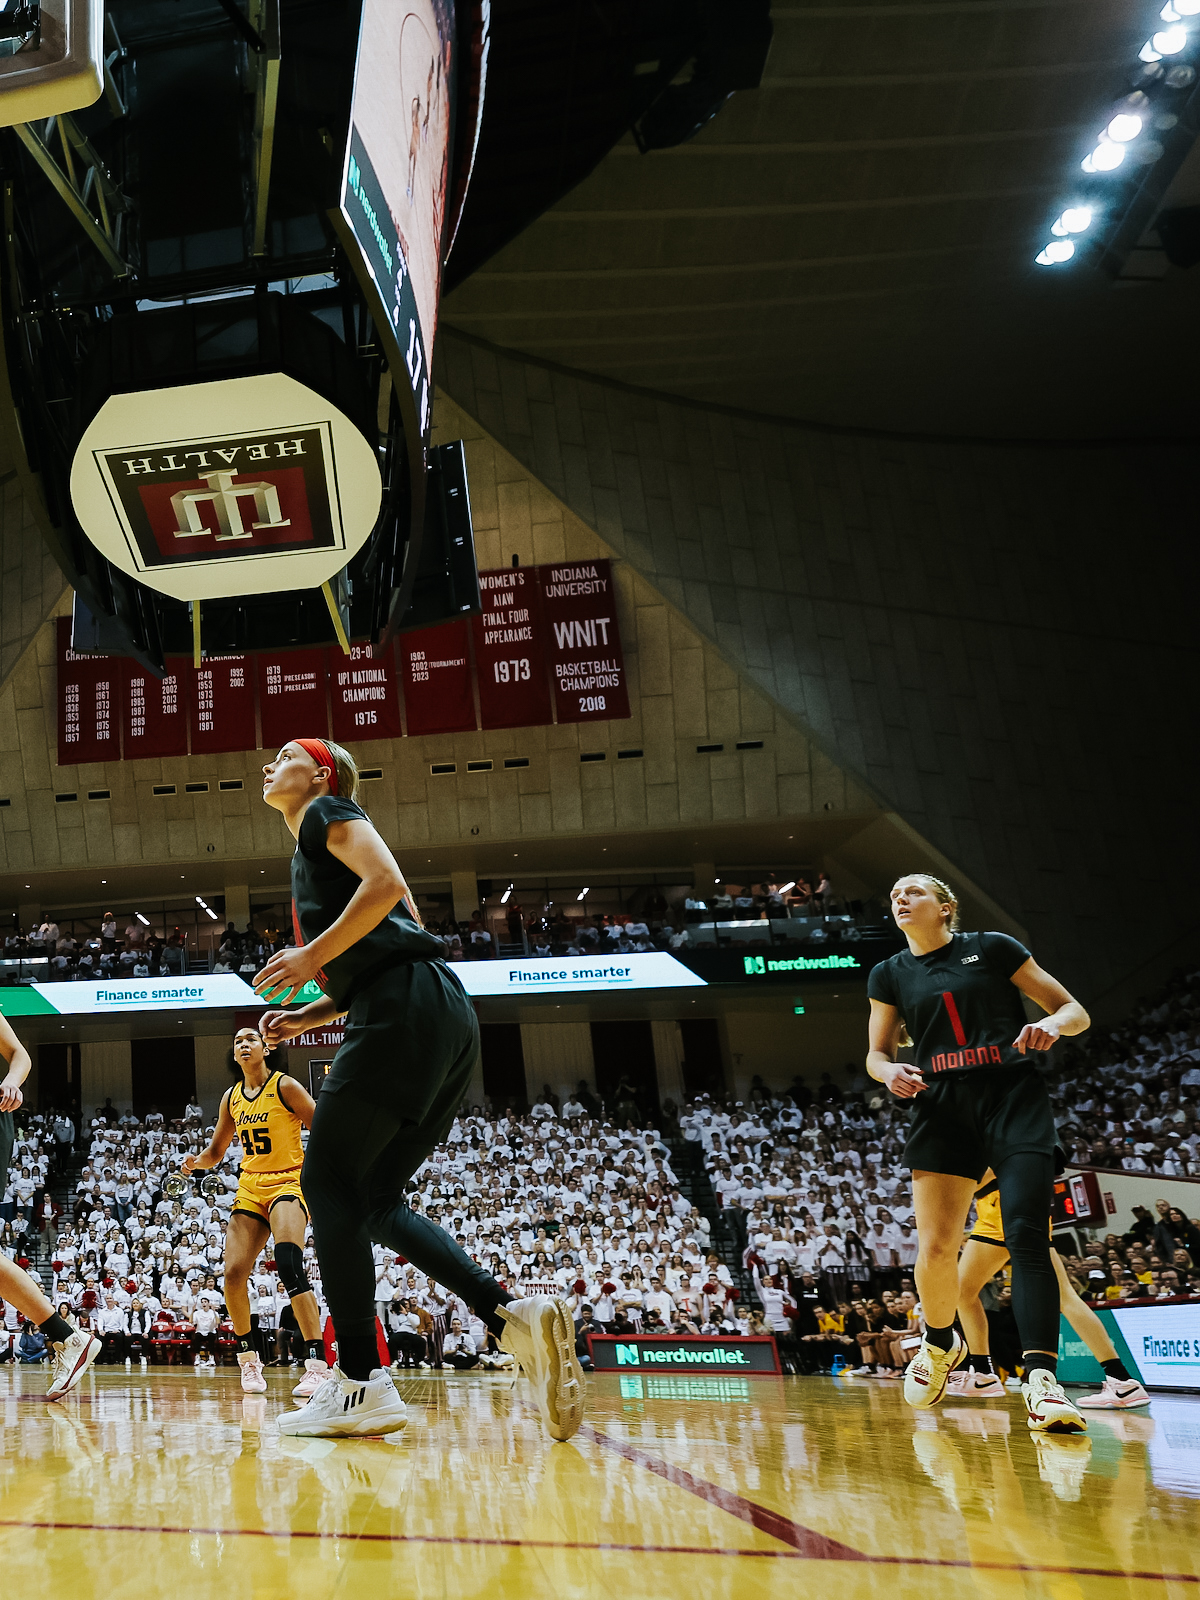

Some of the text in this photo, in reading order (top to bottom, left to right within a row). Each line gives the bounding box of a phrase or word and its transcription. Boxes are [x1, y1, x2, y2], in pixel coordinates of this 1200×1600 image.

[122, 438, 307, 475] HEALTH
[479, 572, 525, 590] WOMEN'S
[551, 565, 598, 582] INDIANA
[546, 579, 607, 598] UNIVERSITY
[493, 592, 514, 607] AIAW
[482, 608, 530, 626] FINAL FOUR
[484, 626, 533, 645] APPEARANCE
[553, 618, 610, 650] WNIT
[411, 661, 428, 672] 2002
[494, 658, 531, 683] 1973
[556, 659, 620, 677] BASKETBALL
[198, 680, 213, 690] 1953
[230, 678, 244, 687] 2002
[338, 669, 388, 686] UPI NATIONAL
[412, 672, 429, 682] 2023
[560, 674, 620, 692] CHAMPIONS
[162, 685, 177, 694] 2002
[198, 690, 213, 700] 1973
[343, 686, 386, 702] CHAMPIONS
[162, 695, 177, 704] 2013
[579, 696, 606, 712] 2018
[96, 710, 110, 720] 1974
[162, 705, 177, 714] 2016
[354, 710, 378, 725] 1975
[66, 724, 79, 732] 1954
[96, 721, 110, 730] 1975
[66, 733, 79, 742] 1957
[509, 966, 630, 982] Finance smarter
[96, 986, 204, 1001] Finance smarter
[942, 992, 967, 1046] 1
[931, 1045, 1002, 1074] INDIANA
[236, 1110, 270, 1126] Iowa
[241, 1128, 272, 1155] 45
[1143, 1335, 1190, 1358] Finance
